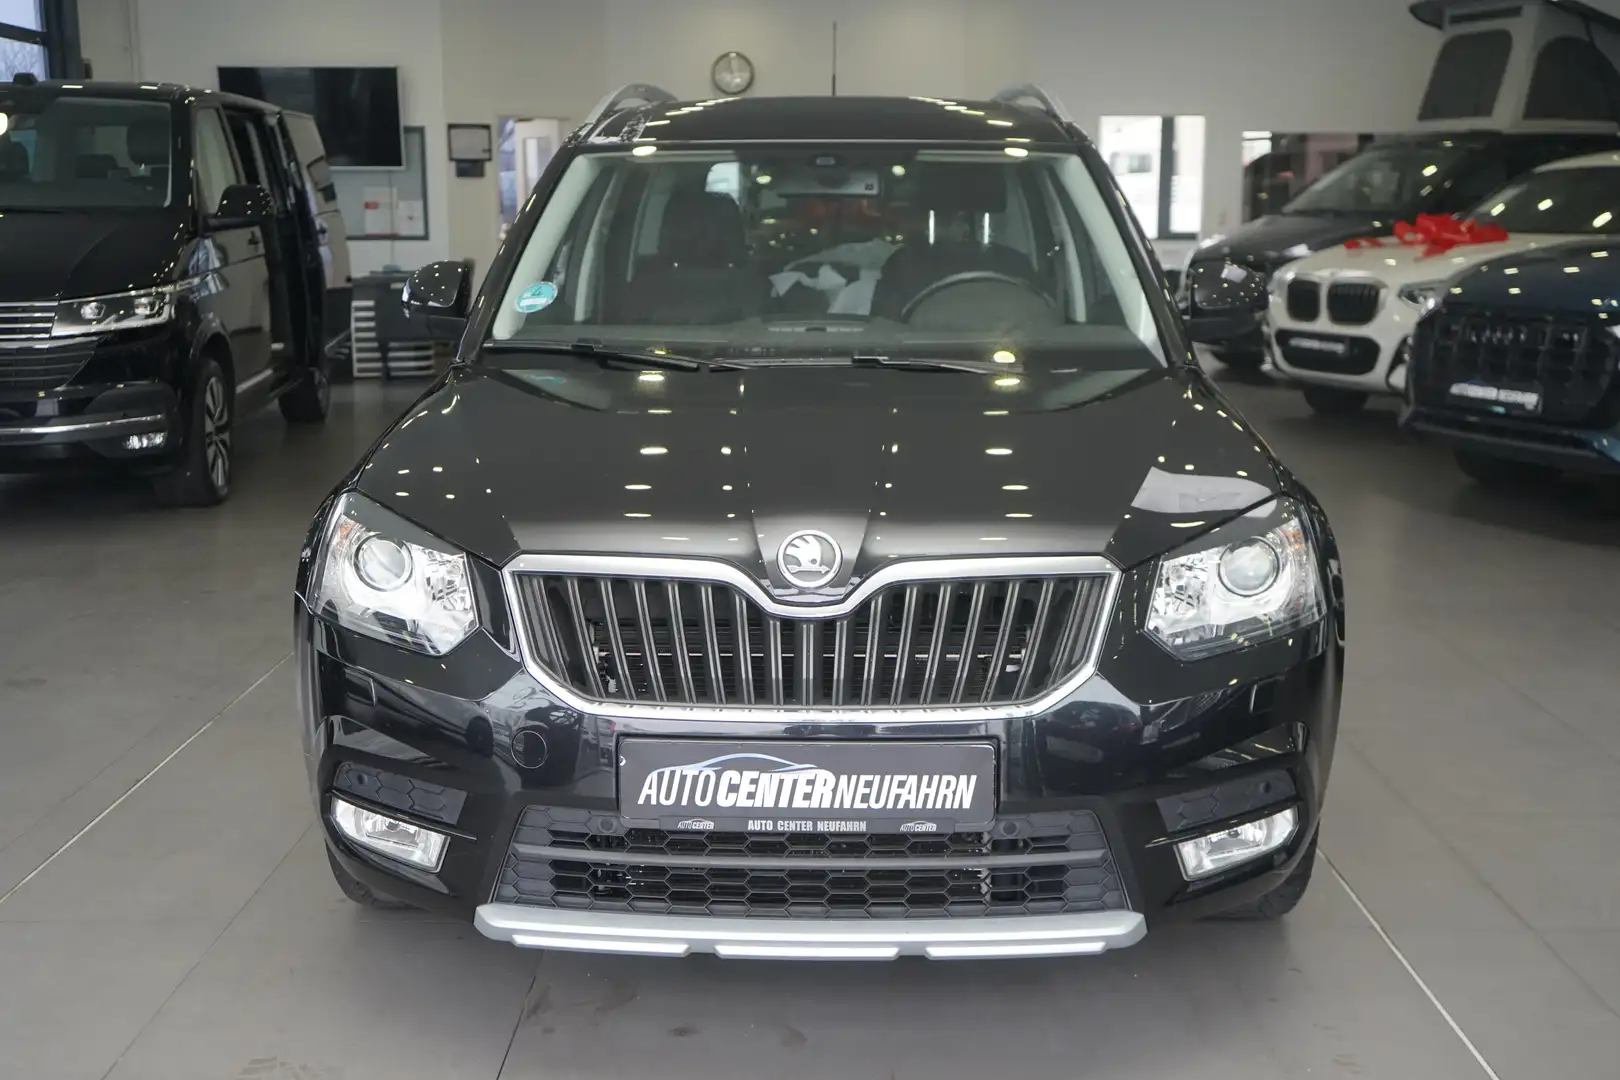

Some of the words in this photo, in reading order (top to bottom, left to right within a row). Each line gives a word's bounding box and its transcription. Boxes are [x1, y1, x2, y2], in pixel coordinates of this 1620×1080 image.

[747, 820, 773, 831] AUTO
[777, 820, 813, 831] CENTER
[817, 820, 867, 832] NEUFAHRN
